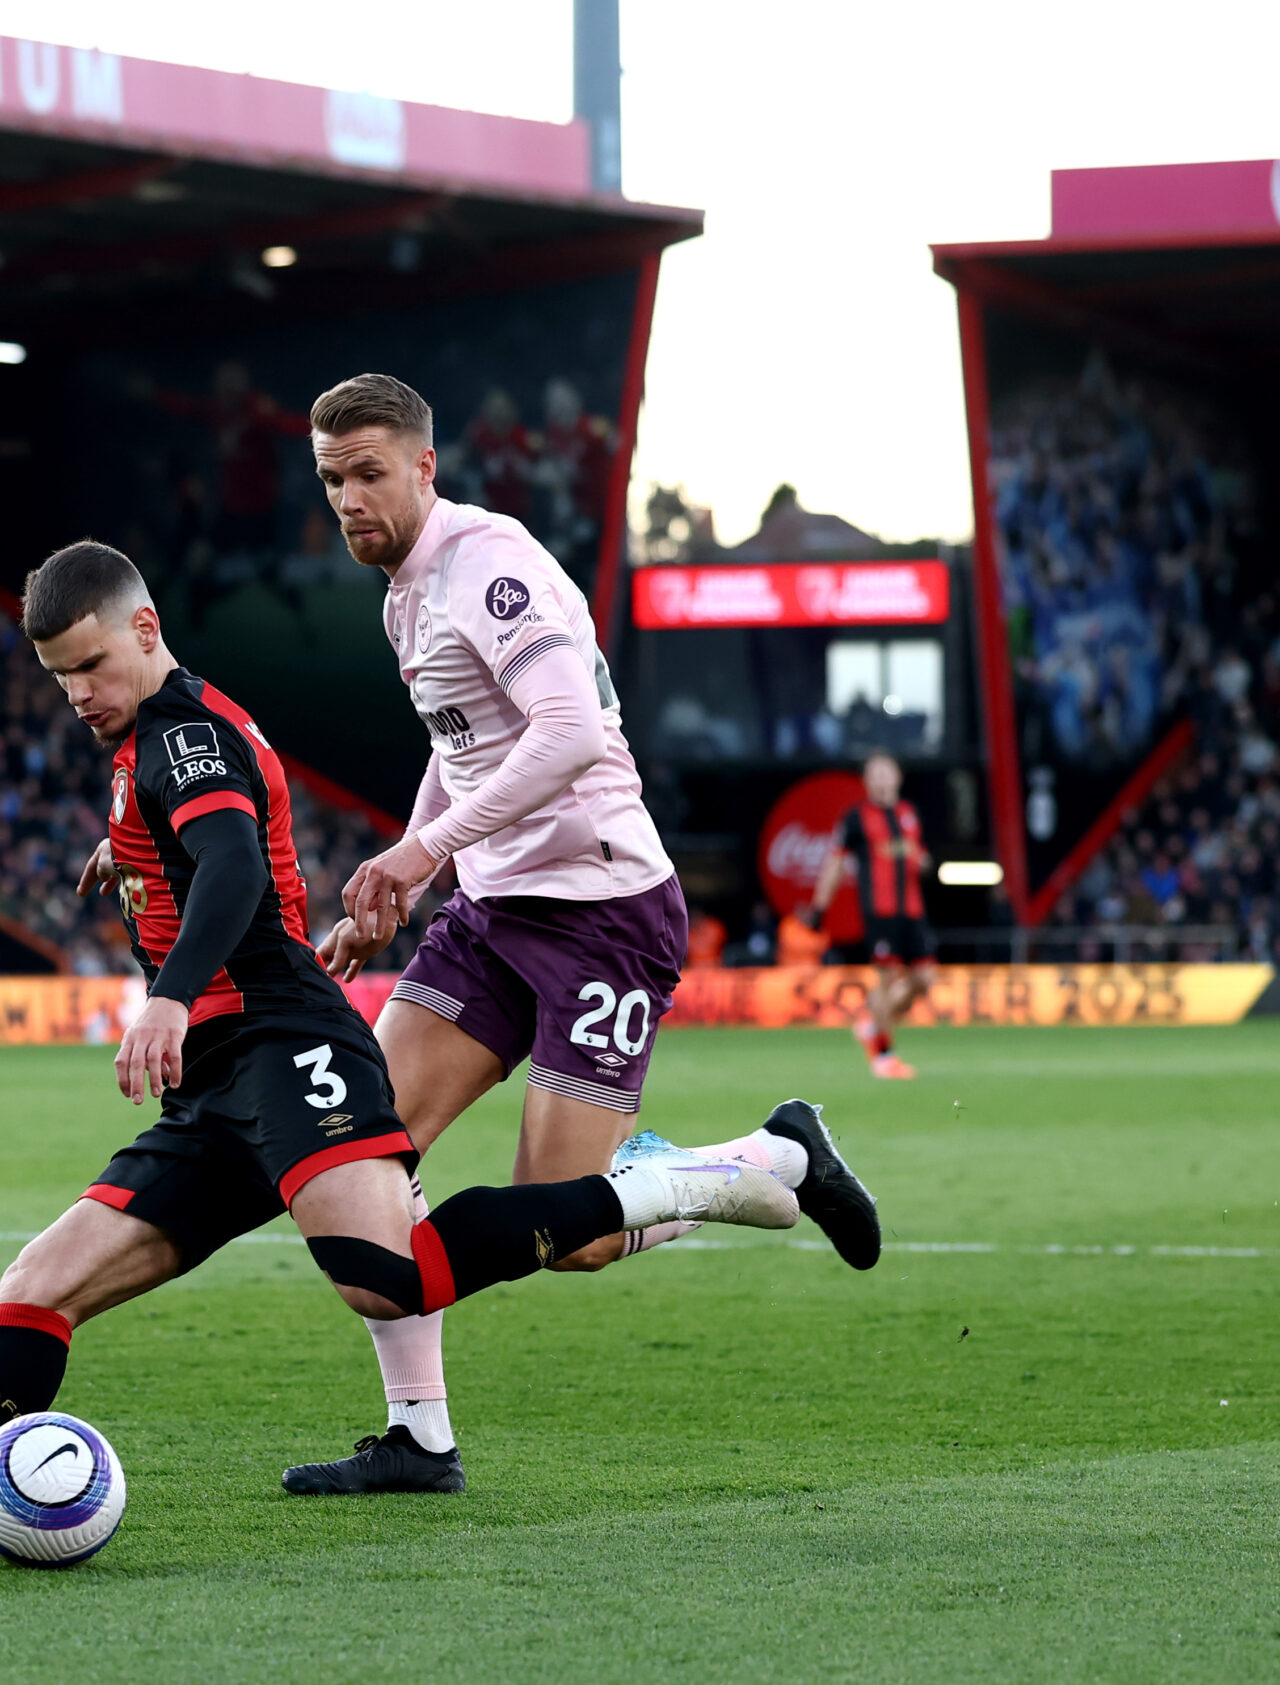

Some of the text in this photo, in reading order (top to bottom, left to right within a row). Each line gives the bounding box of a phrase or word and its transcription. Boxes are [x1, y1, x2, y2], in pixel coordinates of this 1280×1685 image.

[171, 758, 227, 787] LEOS
[570, 981, 651, 1056] 20
[292, 1043, 347, 1109] 3
[596, 1066, 620, 1078] umbro
[325, 1124, 354, 1138] umbro
